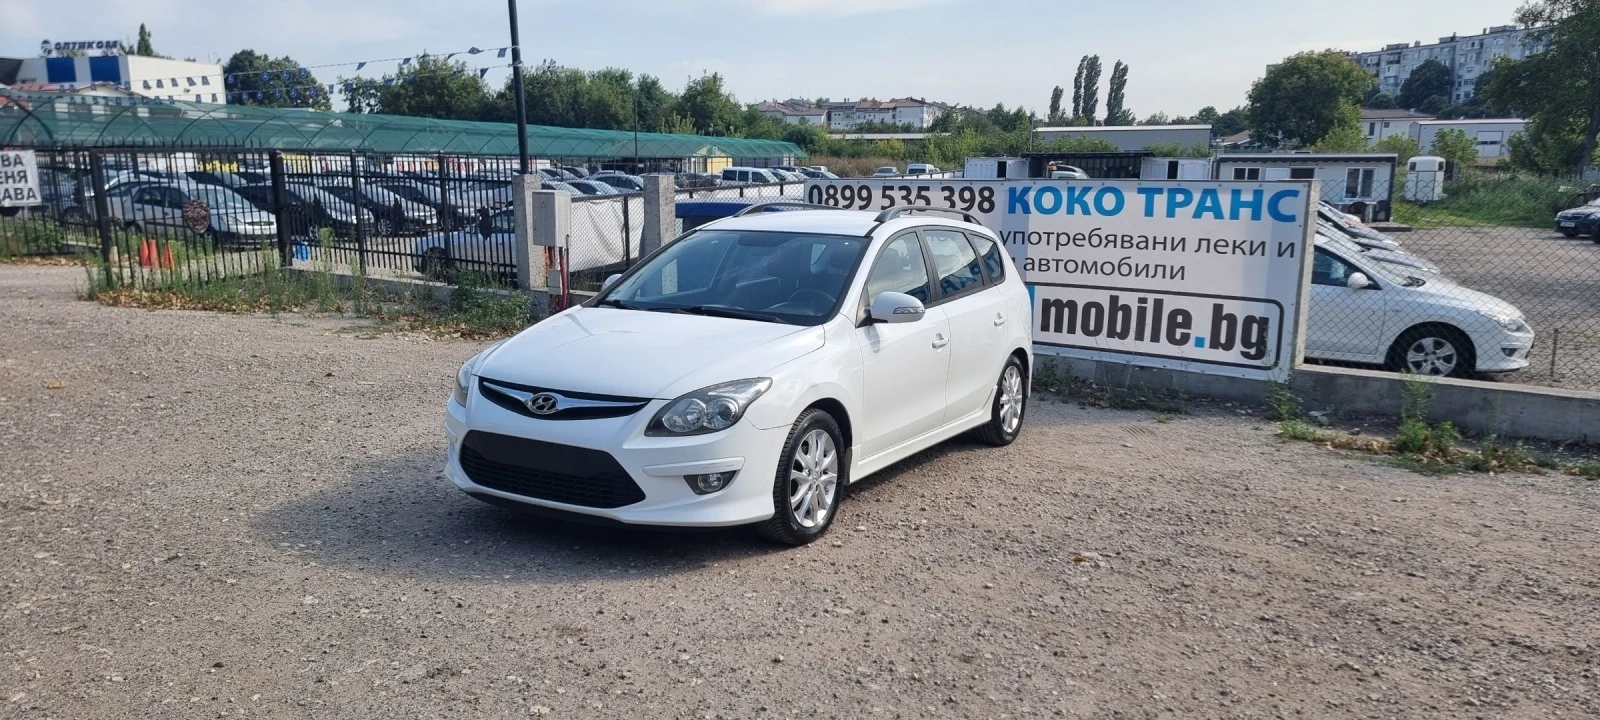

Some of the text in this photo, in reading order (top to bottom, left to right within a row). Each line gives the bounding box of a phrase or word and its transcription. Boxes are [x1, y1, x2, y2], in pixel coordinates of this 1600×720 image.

[0, 187, 38, 203] АВА
[808, 184, 1301, 223] 0899 535 398 КОКО ТРАНС
[1000, 227, 1295, 259] употребявани леки и
[1023, 256, 1186, 281] автомобили
[1040, 294, 1270, 361] mobile.bg
